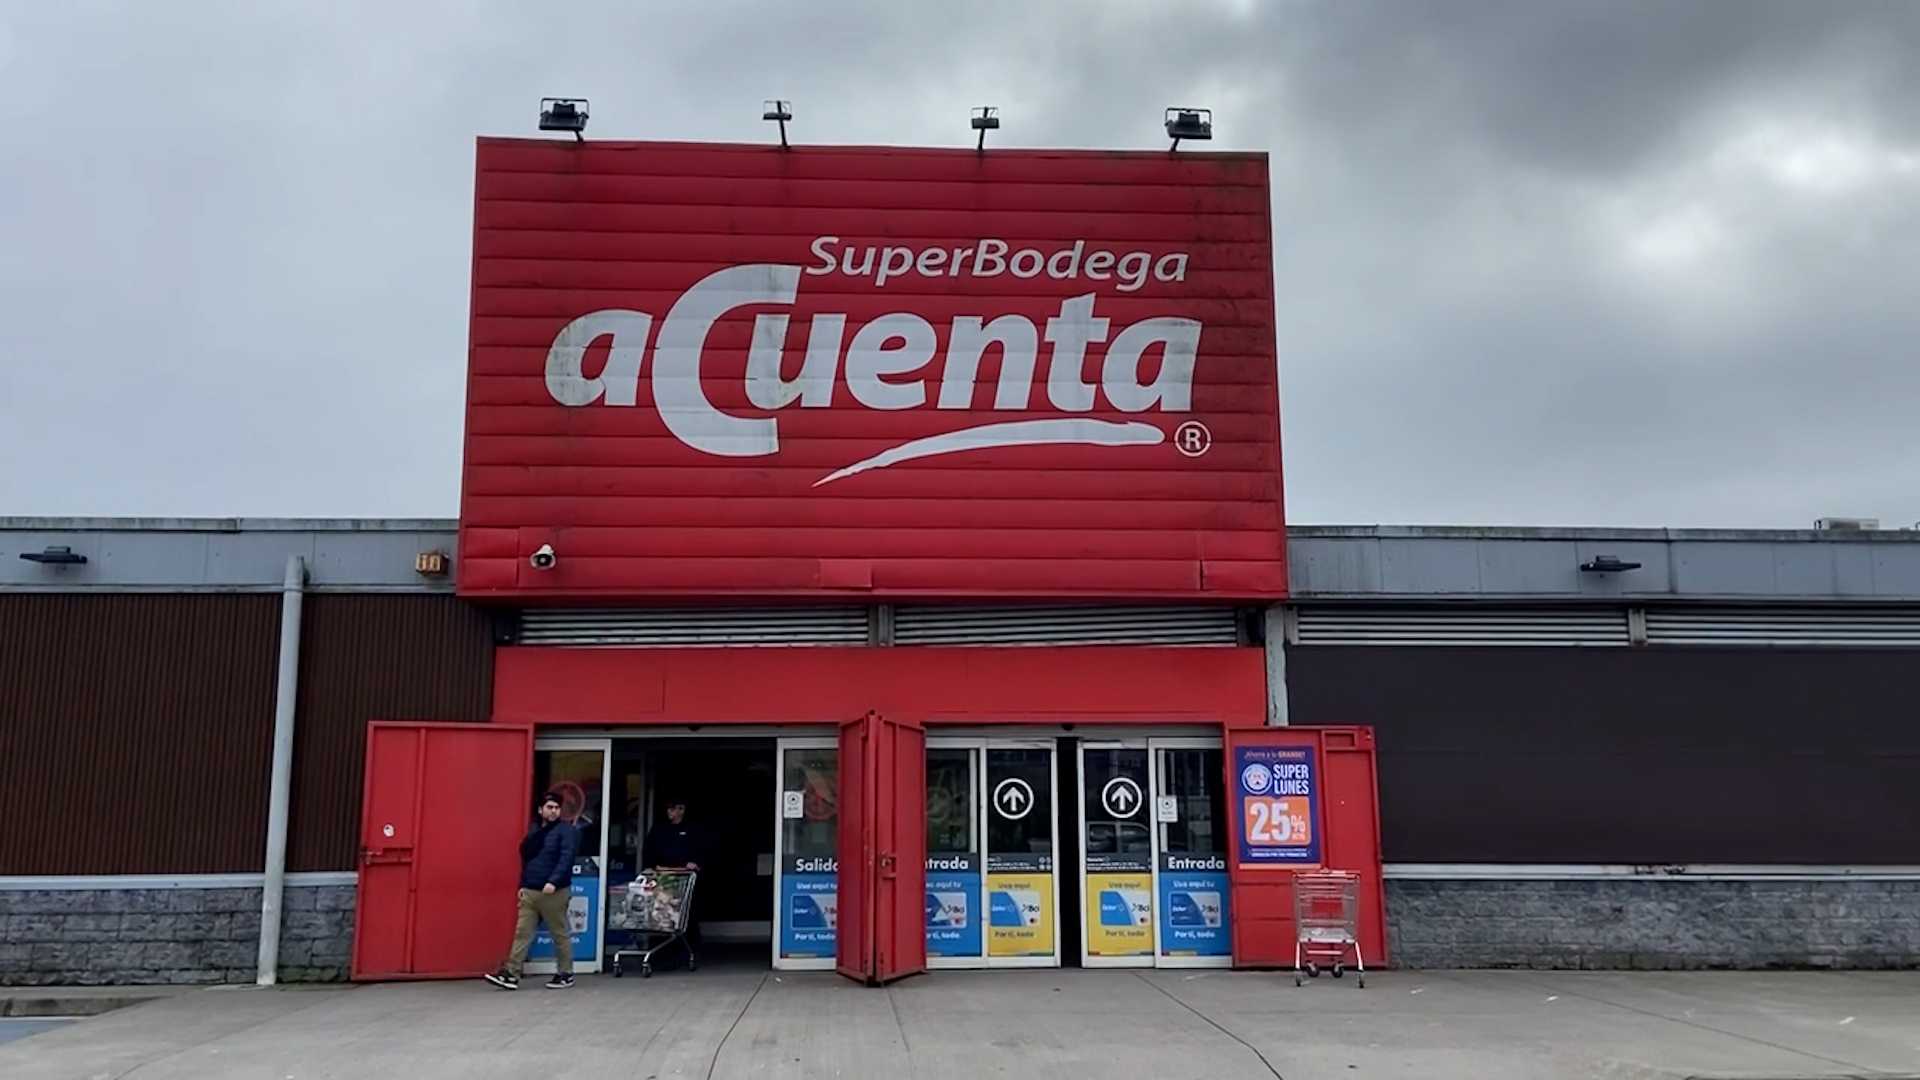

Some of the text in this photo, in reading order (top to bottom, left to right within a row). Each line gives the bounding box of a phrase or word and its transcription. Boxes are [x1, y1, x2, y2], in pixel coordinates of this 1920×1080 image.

[806, 236, 1189, 291] SuperBodega
[545, 263, 1202, 458] aCuenta
[1273, 764, 1309, 779] SUPER
[1274, 780, 1309, 794] LUNES
[925, 856, 969, 870] trada
[1168, 856, 1225, 869] Entrada
